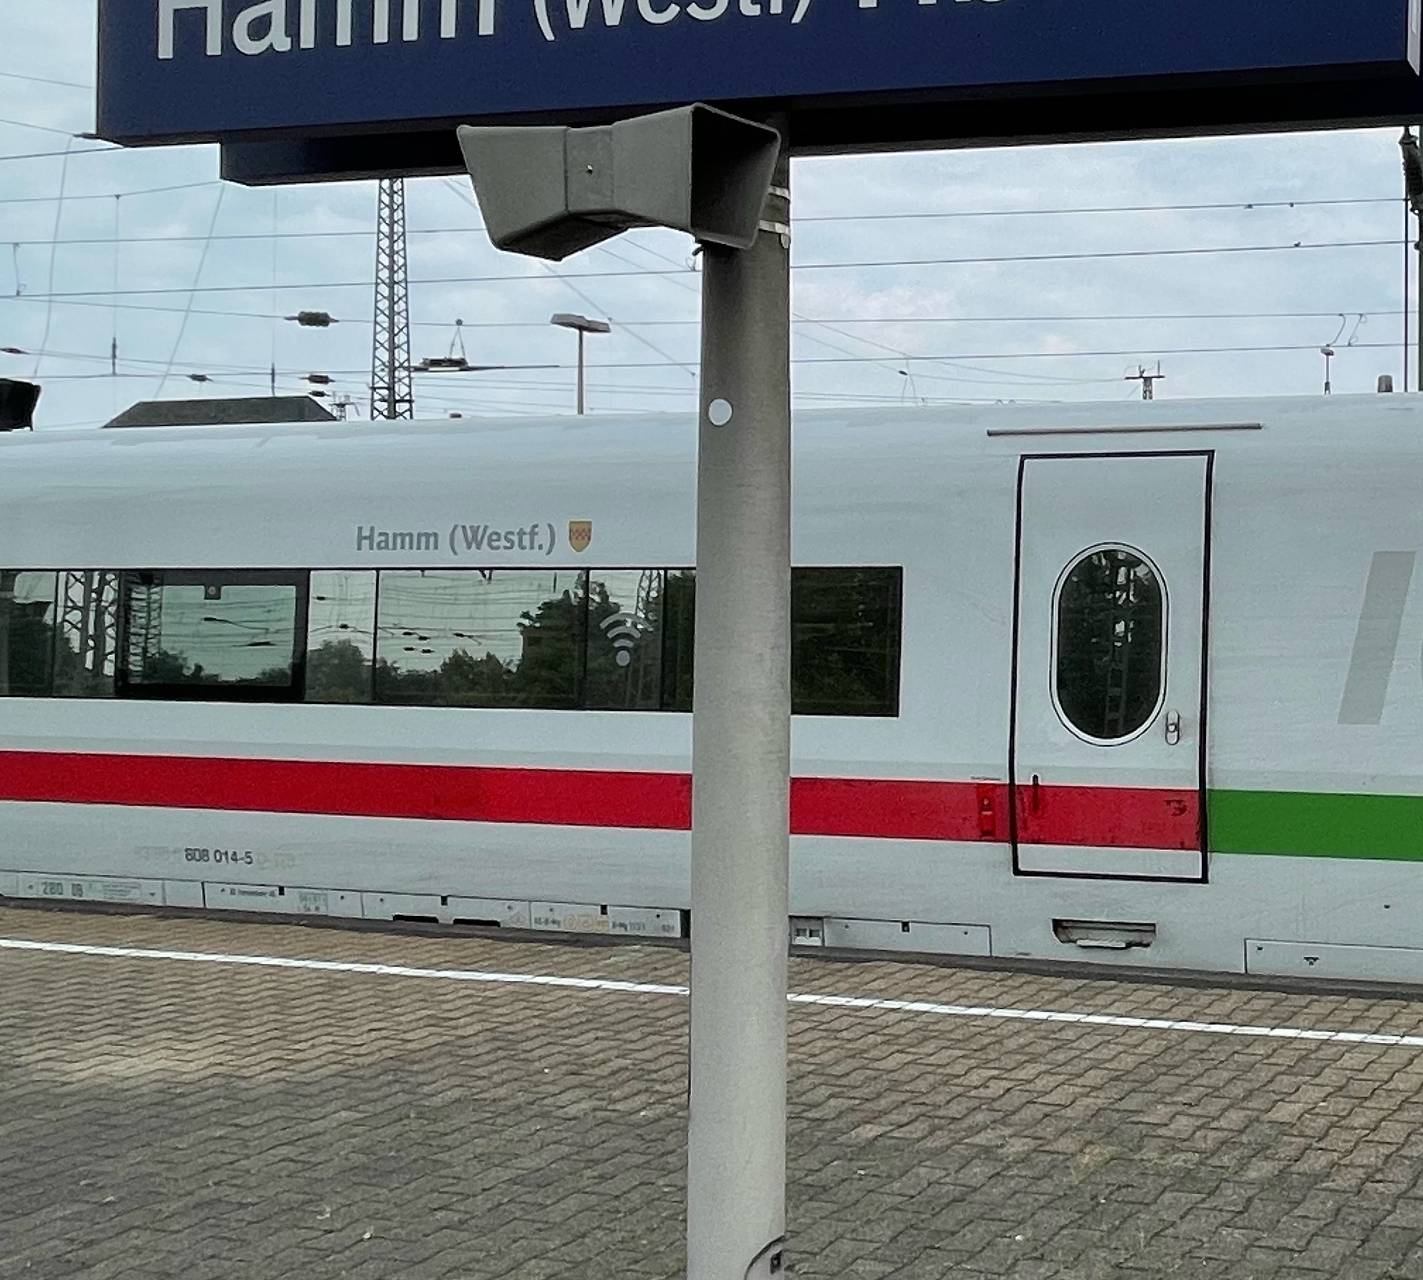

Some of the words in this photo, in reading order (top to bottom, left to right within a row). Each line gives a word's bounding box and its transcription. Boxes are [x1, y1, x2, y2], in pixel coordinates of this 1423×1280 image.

[355, 525, 440, 552] Hamm
[449, 522, 557, 556] (Westf.)
[213, 848, 255, 866] 014-5
